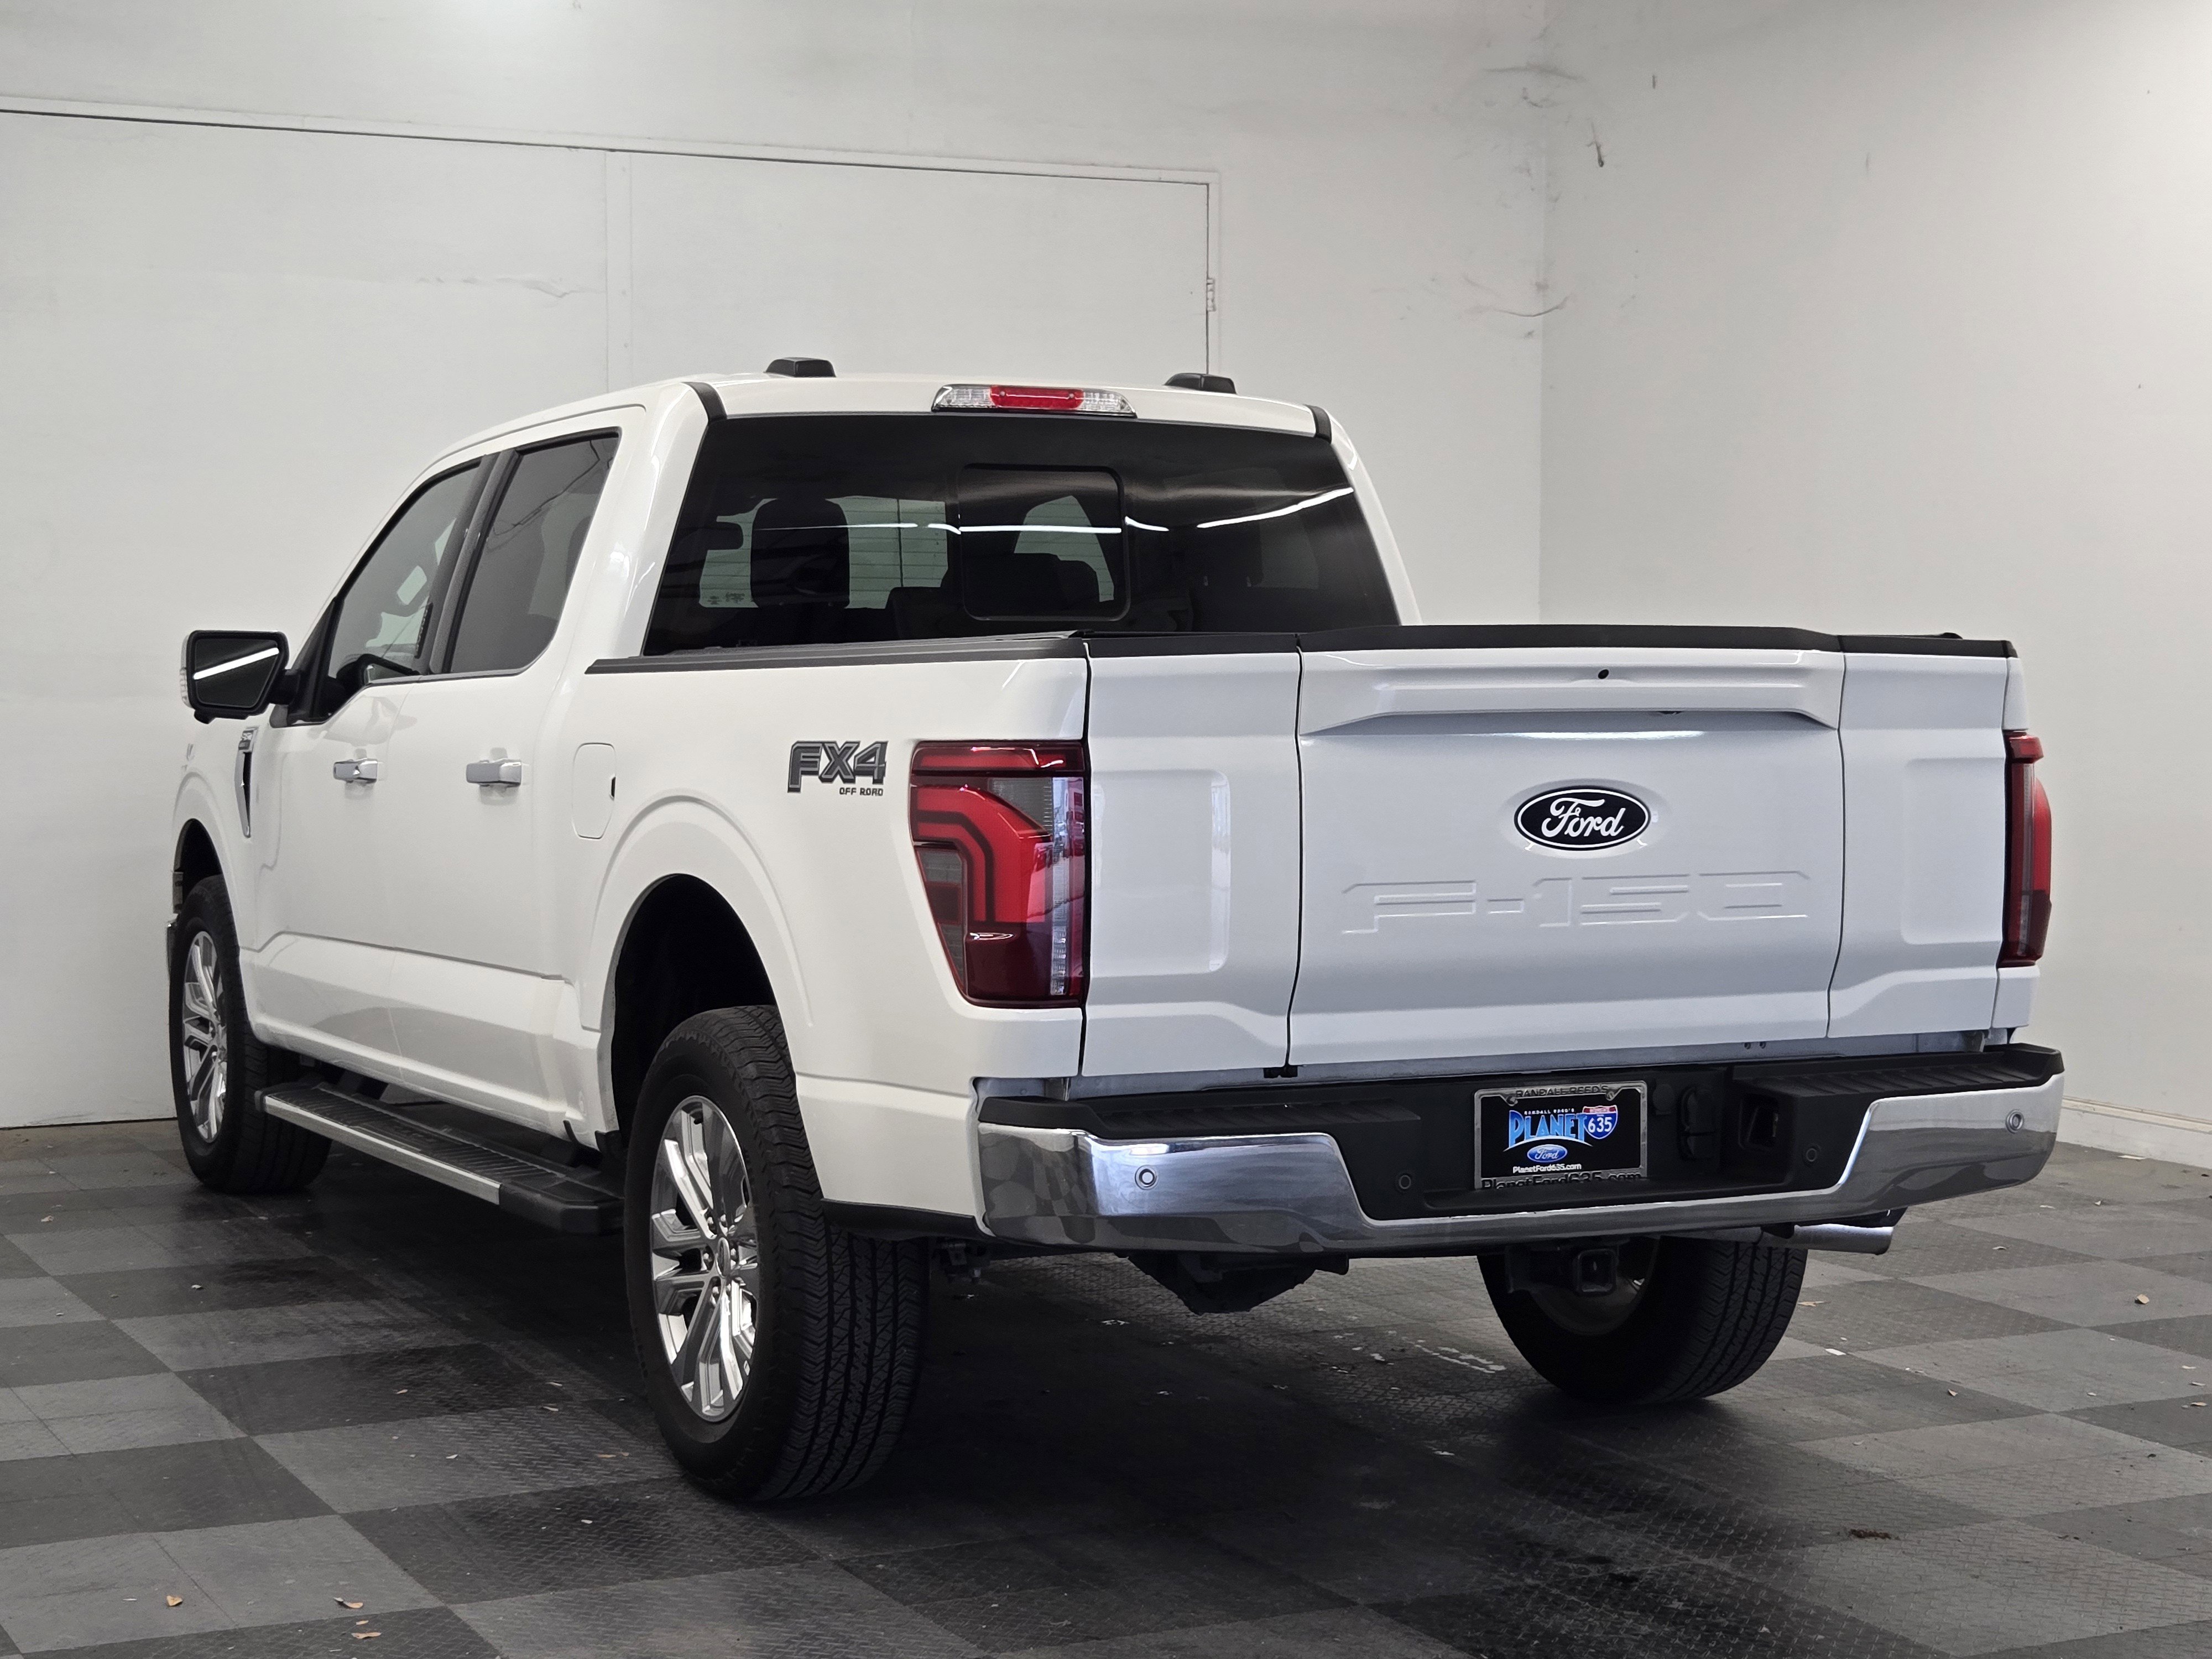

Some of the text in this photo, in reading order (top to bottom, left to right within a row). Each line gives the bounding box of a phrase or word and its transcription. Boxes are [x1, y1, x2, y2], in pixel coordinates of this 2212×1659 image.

[787, 740, 889, 793] FX4
[839, 787, 884, 796] OFF ROAD
[1541, 797, 1626, 837] Ford
[1342, 870, 1809, 935] F-150
[1516, 1088, 1569, 1098] RANDALL
[1509, 1110, 1587, 1147] PLANET
[1588, 1117, 1613, 1133] 635
[1534, 1148, 1559, 1161] Ford
[1512, 1163, 1582, 1173] PlanetFord635.com
